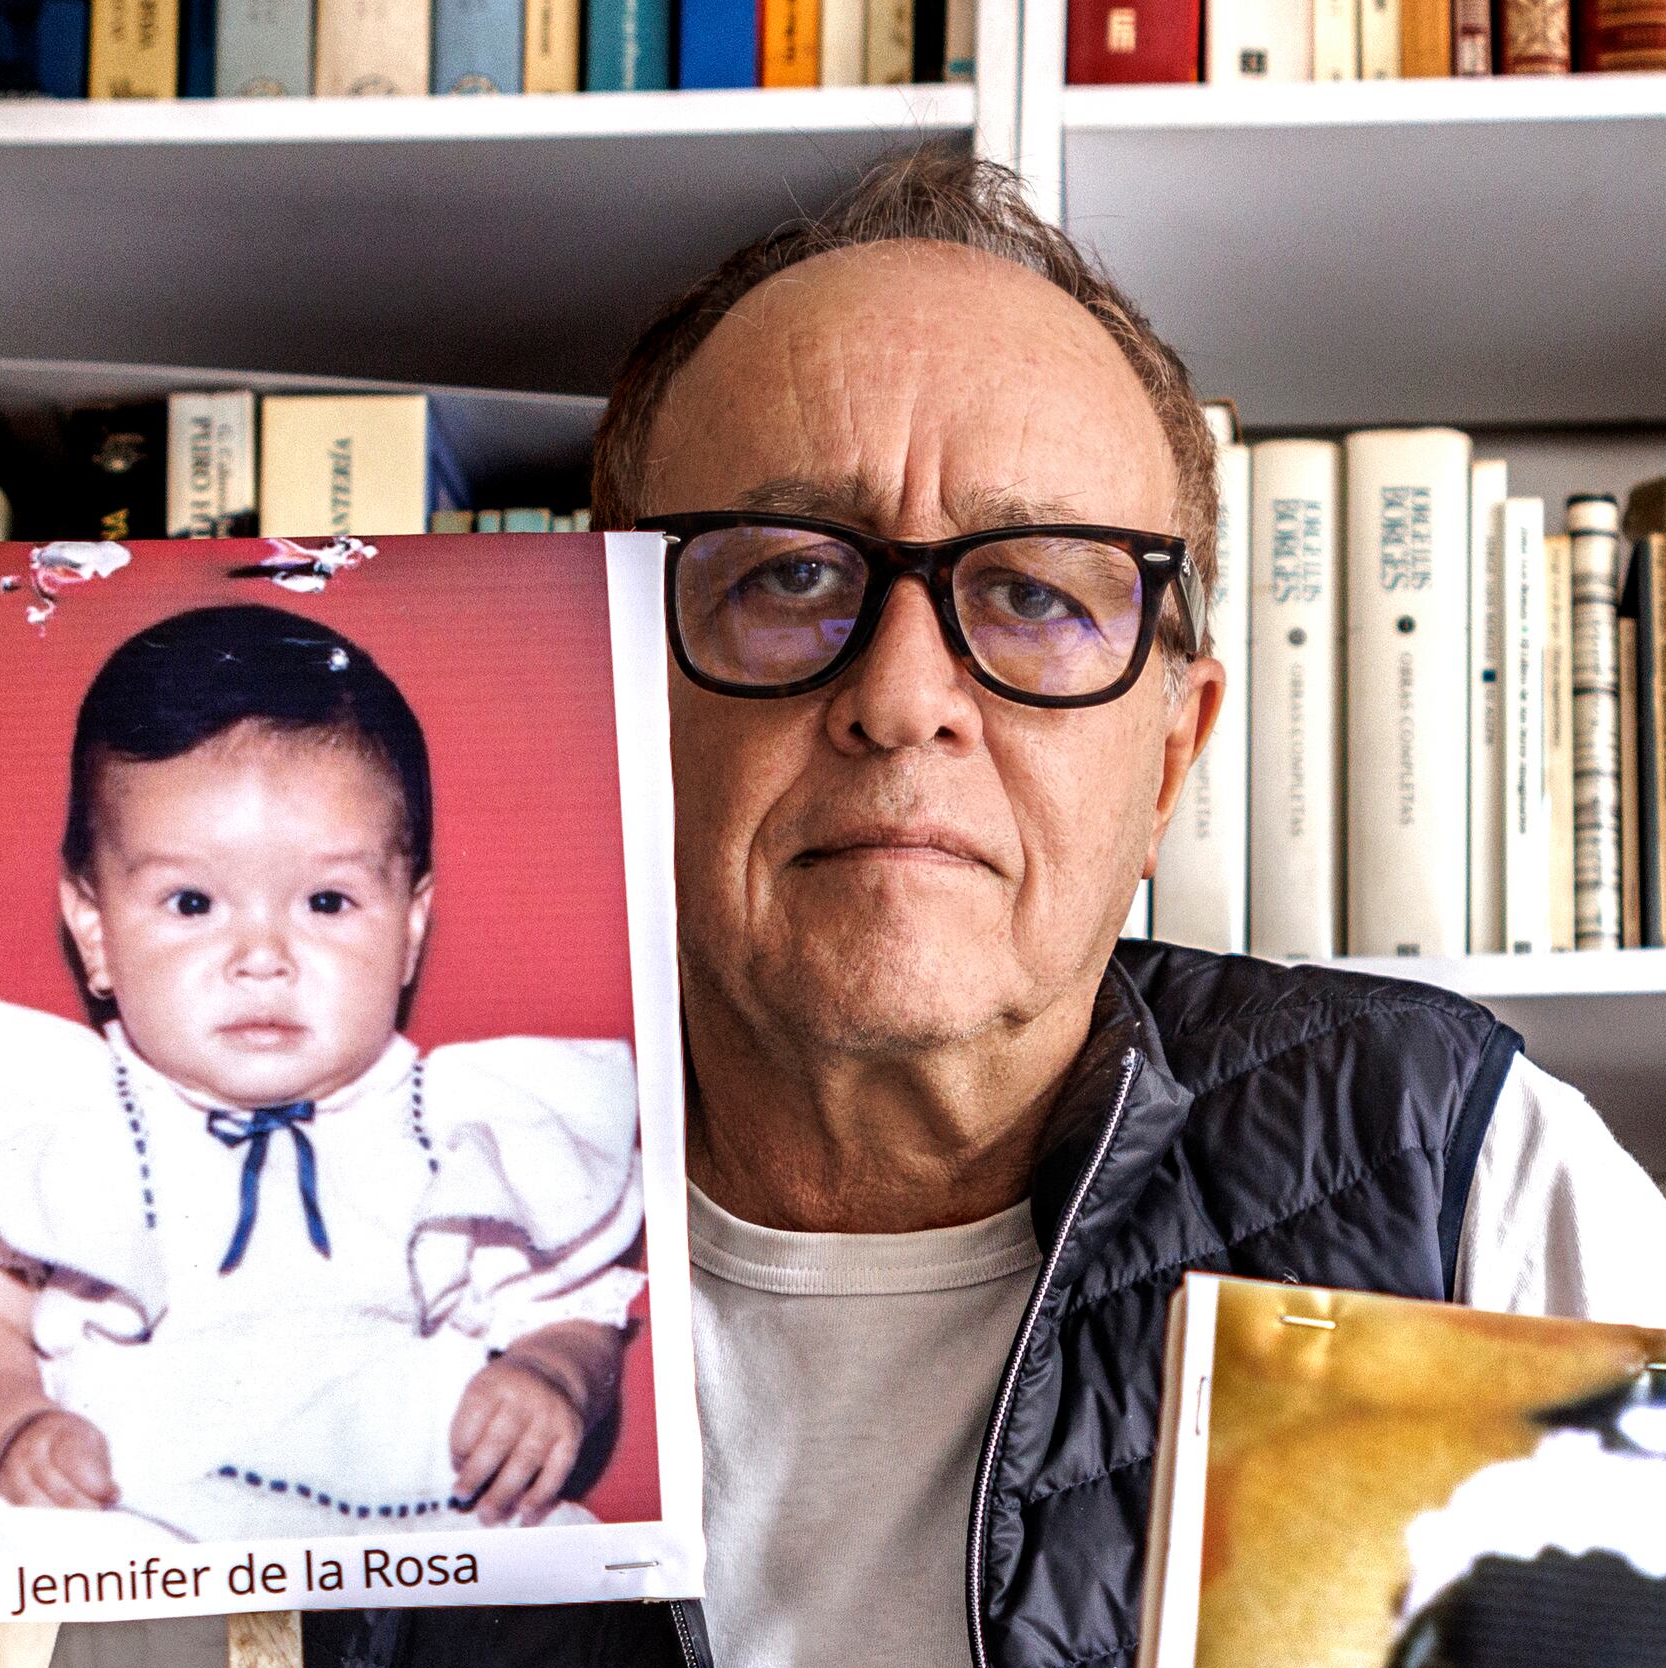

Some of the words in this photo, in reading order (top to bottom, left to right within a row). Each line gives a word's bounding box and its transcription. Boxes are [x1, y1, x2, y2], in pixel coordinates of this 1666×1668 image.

[1271, 499, 1302, 605] BORGES
[1379, 486, 1411, 592] BORGES
[1399, 651, 1416, 710] OBRAS
[1289, 726, 1305, 837] COMPLETAS
[1398, 715, 1416, 826] COMPLETAS
[12, 1556, 211, 1616] Jennifer
[227, 1552, 289, 1596] de
[303, 1549, 345, 1592] la
[364, 1548, 480, 1588] Rosa
